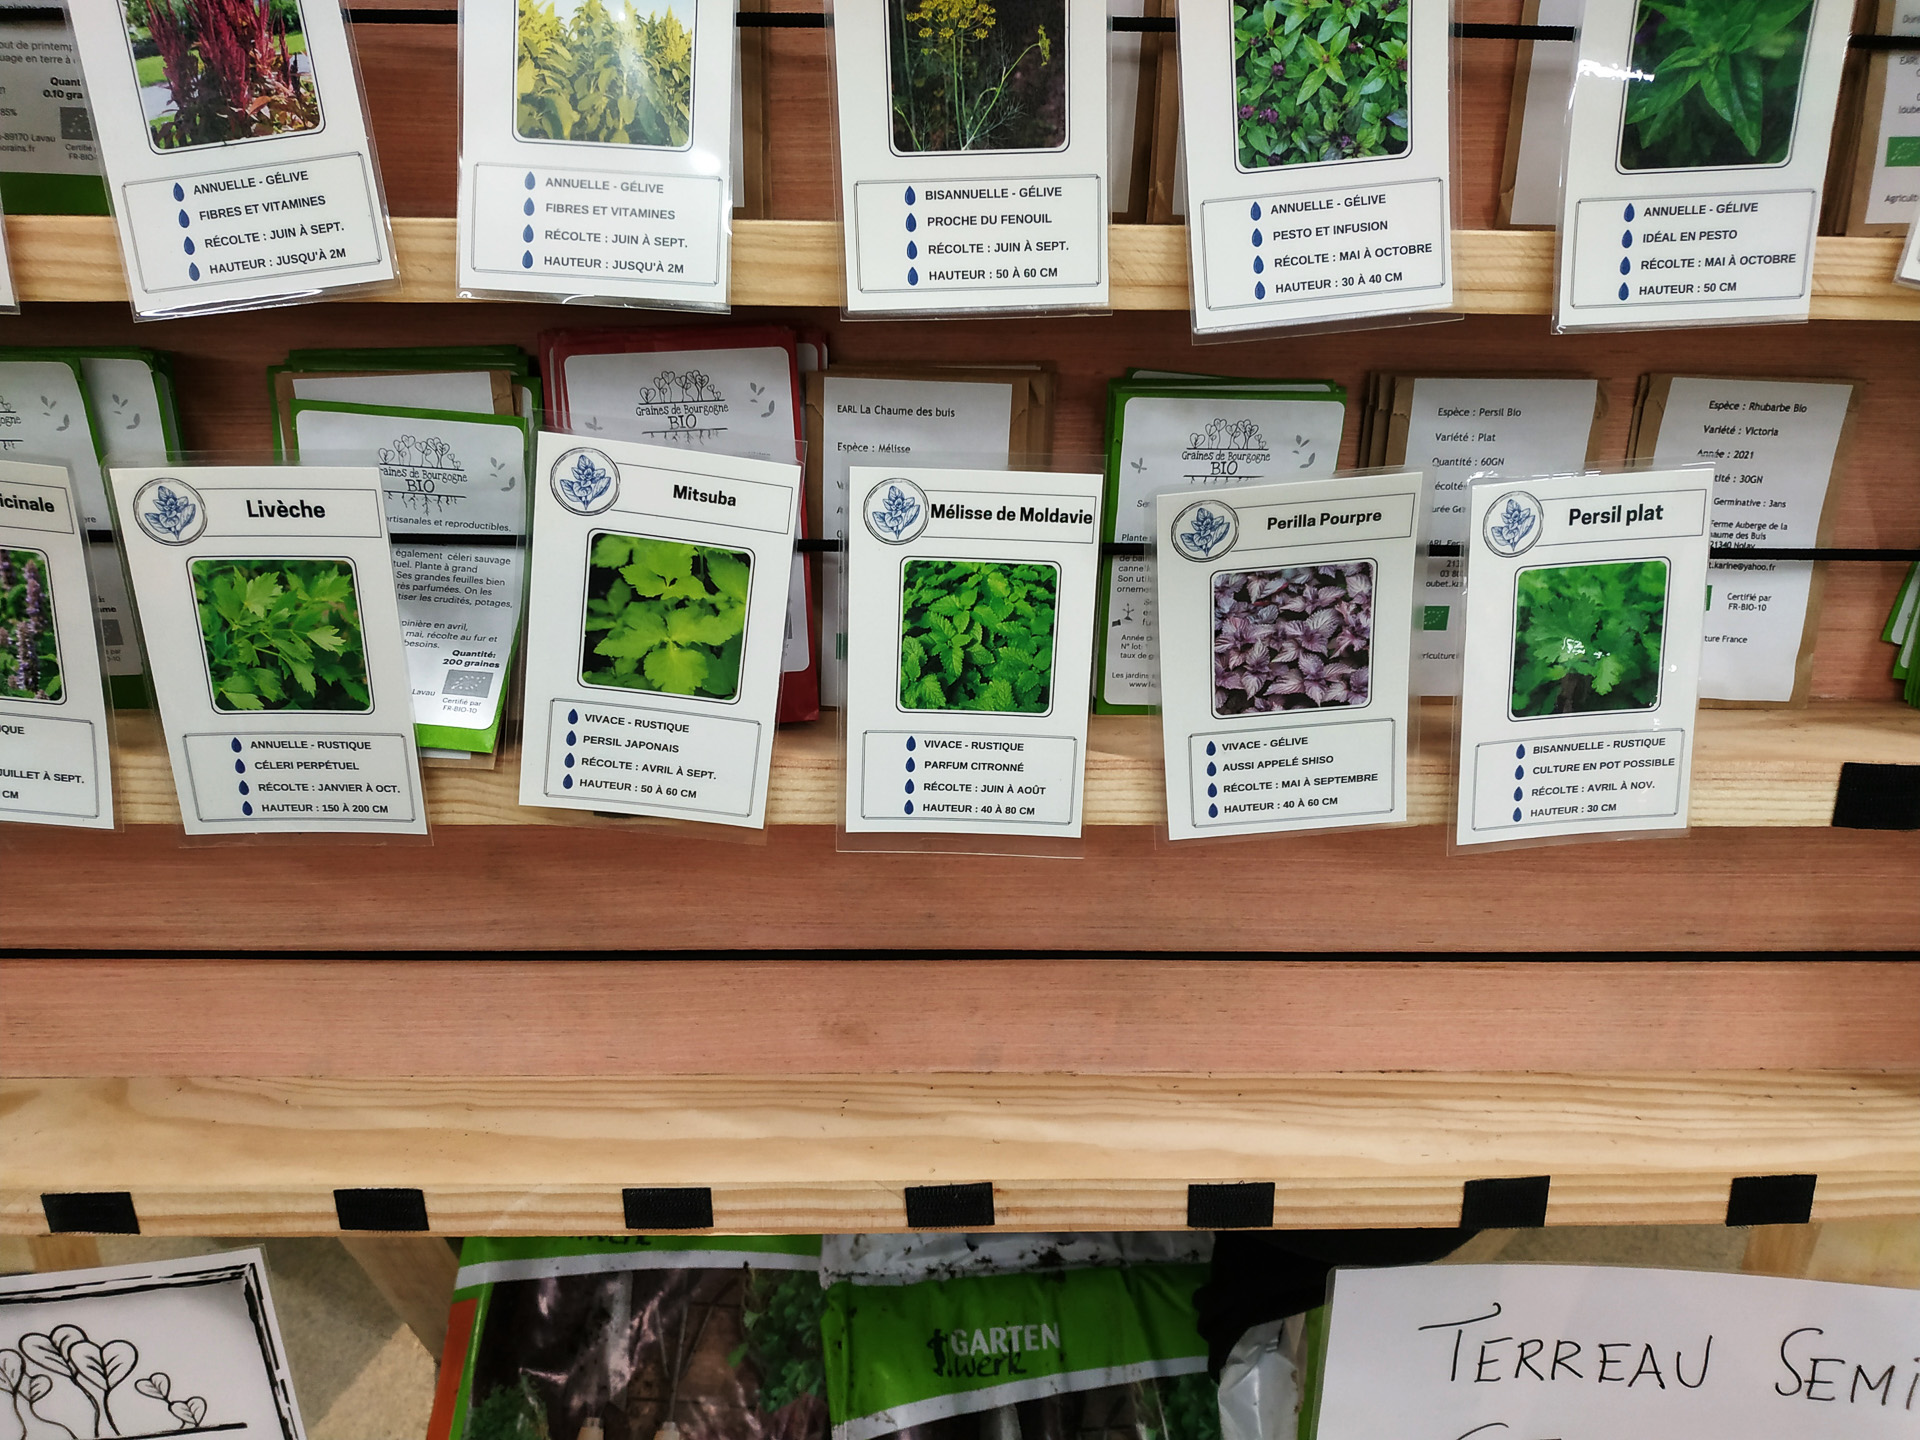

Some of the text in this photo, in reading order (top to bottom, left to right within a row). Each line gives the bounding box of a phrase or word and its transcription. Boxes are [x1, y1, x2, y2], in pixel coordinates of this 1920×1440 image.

[16, 41, 29, 50] de
[40, 55, 59, 64] terre
[43, 90, 64, 98] 0.10
[194, 171, 308, 195] ANNUELLE GÉLIVE
[546, 178, 664, 194] ANNUELLE GÉLIVE
[926, 185, 1062, 200] BISANNUELLE GÉLIVE
[200, 196, 326, 220] FIBRES ET VITAMINES
[1271, 194, 1386, 214] ANNUELLE GÉLIVE
[1644, 202, 1758, 216] ANNUELLE GÉLIVE
[546, 203, 675, 220] FIBRES ET VITAMINES
[928, 214, 1052, 226] PROCHE DU FENOUIL
[205, 222, 344, 248] RÉCOLTE JUIN À SEPT.
[1274, 221, 1388, 240] PESTO ET INFUSION
[1643, 230, 1737, 243] IDÉAL EN PESTO
[544, 256, 684, 274] HAUTEUR JUSQU'À 2M
[1640, 282, 1736, 295] HAUTEUR 50 CM
[636, 403, 729, 416] Graines de Bourgogne
[837, 405, 956, 418] EARL La Chaume des buis
[1438, 408, 1522, 418] Espèce Persil Bio
[1709, 401, 1807, 413] Espèce Rhubarbe Bio
[668, 414, 697, 430] BIO
[1703, 425, 1779, 436] Variété Victoria
[1435, 433, 1496, 442] Variété Plat
[837, 443, 911, 454] Espèce Mélisse
[1733, 450, 1754, 459] 2021
[1182, 451, 1271, 464] Graines de Bourgogne
[1432, 457, 1504, 467] Quantité 60GN
[1211, 461, 1238, 476] BIO
[410, 468, 468, 484] de Bourgogne
[1739, 475, 1763, 484] 30GN
[405, 479, 435, 493] BIO
[674, 485, 736, 506] Mitsuba
[246, 500, 325, 518] Livèche
[1714, 498, 1786, 508] Germinative 3ans
[931, 504, 1093, 524] Mélisse de Moldavie
[1569, 504, 1664, 526] Persil plat
[445, 519, 512, 532] reproductibles.
[1268, 512, 1382, 530] Perilla Pourpre
[1735, 522, 1767, 532] Auberge
[1781, 523, 1788, 531] la
[1122, 534, 1148, 542] Plante
[1736, 532, 1749, 540] des
[415, 562, 478, 574] Plante à grand
[396, 571, 505, 586] Ses grandes feuilles bien
[1727, 593, 1772, 603] Certifié par
[1728, 603, 1767, 612] FR-BIO-10
[406, 631, 424, 639] mai,
[427, 632, 459, 641] récolte
[474, 634, 486, 642] fur
[1722, 636, 1748, 644] France
[452, 650, 496, 659] Quantité:
[442, 658, 500, 669] 200 graines
[585, 714, 689, 733] VIVACE RUSTIQUE
[317, 741, 372, 751] RUSTIQUE
[583, 736, 679, 753] PERSIL JAPONAIS
[924, 740, 1024, 752] VIVACE RUSTIQUE
[1222, 737, 1308, 751] VIVACE GÉLIVE
[1533, 738, 1666, 754] BISANNUELLE RUSTIQUE
[255, 760, 359, 770] CÉLERI PERPÉTUEL
[925, 761, 1024, 772] PARFUM CITRONNÉ
[1223, 756, 1334, 772] AUSSI APPELÉ SHISO
[1533, 758, 1675, 774] CULTURE EN POT POSSIBLE
[43, 770, 51, 780] À
[54, 773, 85, 784] SEPT.
[2, 790, 19, 799] CM
[262, 804, 313, 812] HAUTEUR
[322, 804, 339, 812] 150
[343, 803, 350, 812] À
[372, 805, 388, 813] CM
[1531, 806, 1578, 817] HAUTEUR
[1601, 804, 1616, 812] CM
[951, 1322, 1060, 1357] GARTEN
[1418, 1302, 1713, 1390] TERREAU
